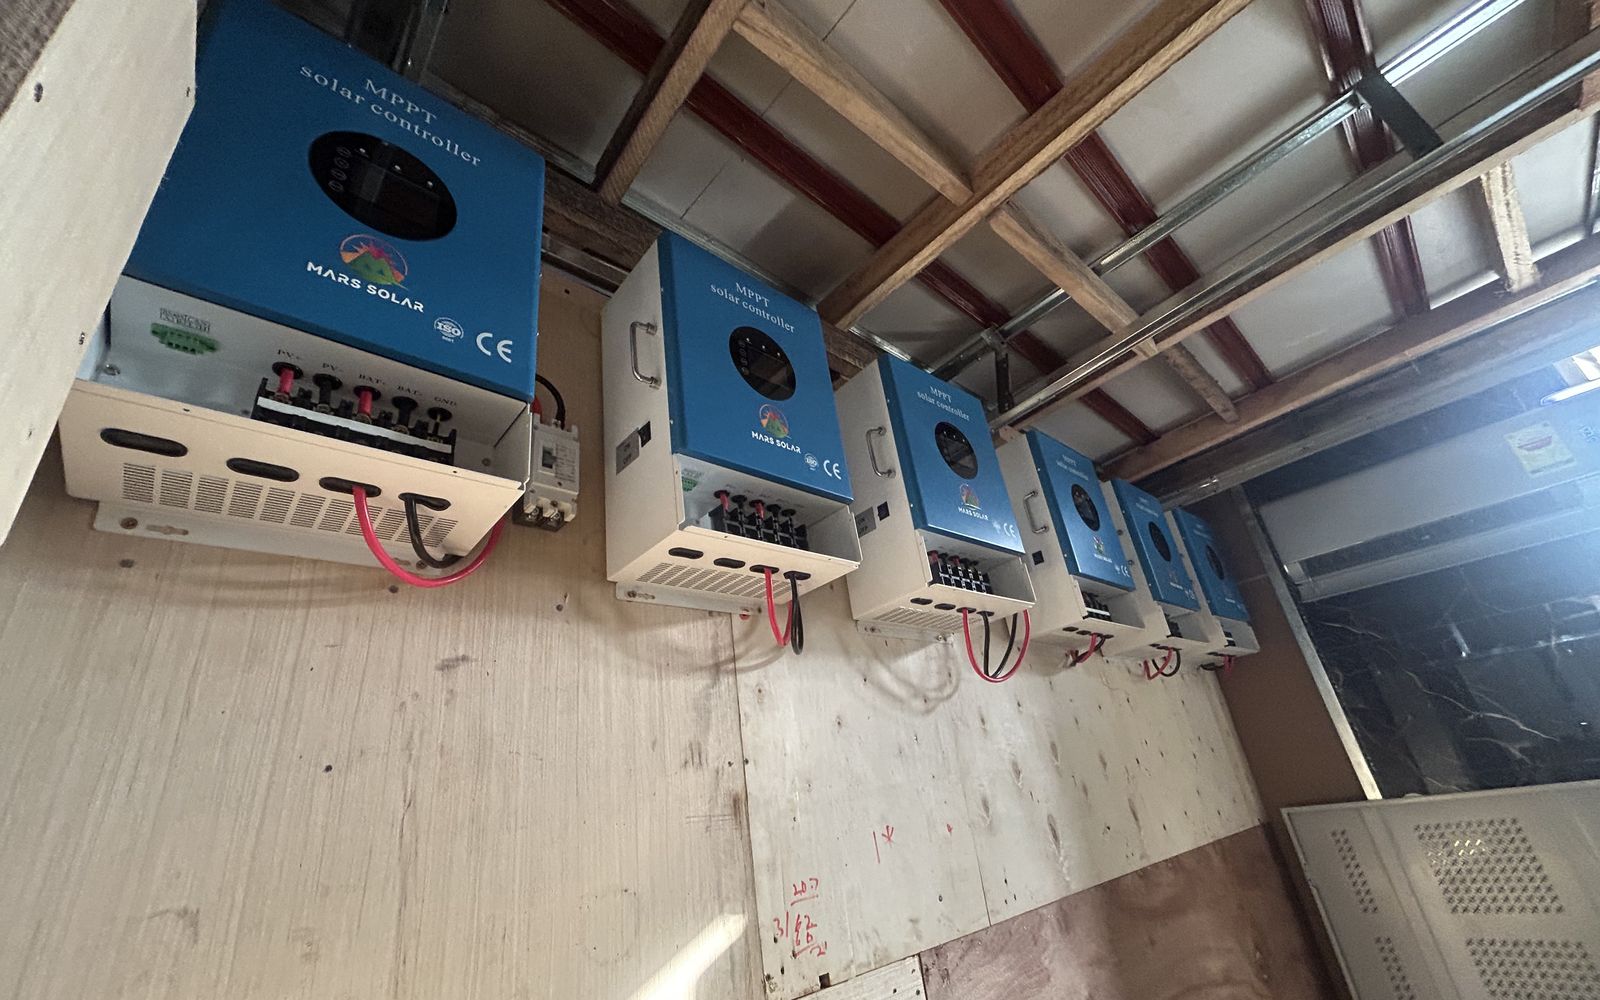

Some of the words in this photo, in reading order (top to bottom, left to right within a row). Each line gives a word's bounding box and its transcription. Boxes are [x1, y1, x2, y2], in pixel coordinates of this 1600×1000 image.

[299, 66, 365, 104] solar
[370, 103, 481, 167] controller
[364, 79, 438, 124] MPPT
[306, 261, 361, 289] MARS
[366, 284, 425, 313] SOLAR
[735, 282, 770, 308] MPPT
[710, 284, 740, 304] solar
[742, 301, 796, 334] controller
[476, 332, 513, 363] CE
[751, 430, 775, 445] MARS
[776, 439, 801, 454] SOLAR
[823, 459, 842, 480] CE
